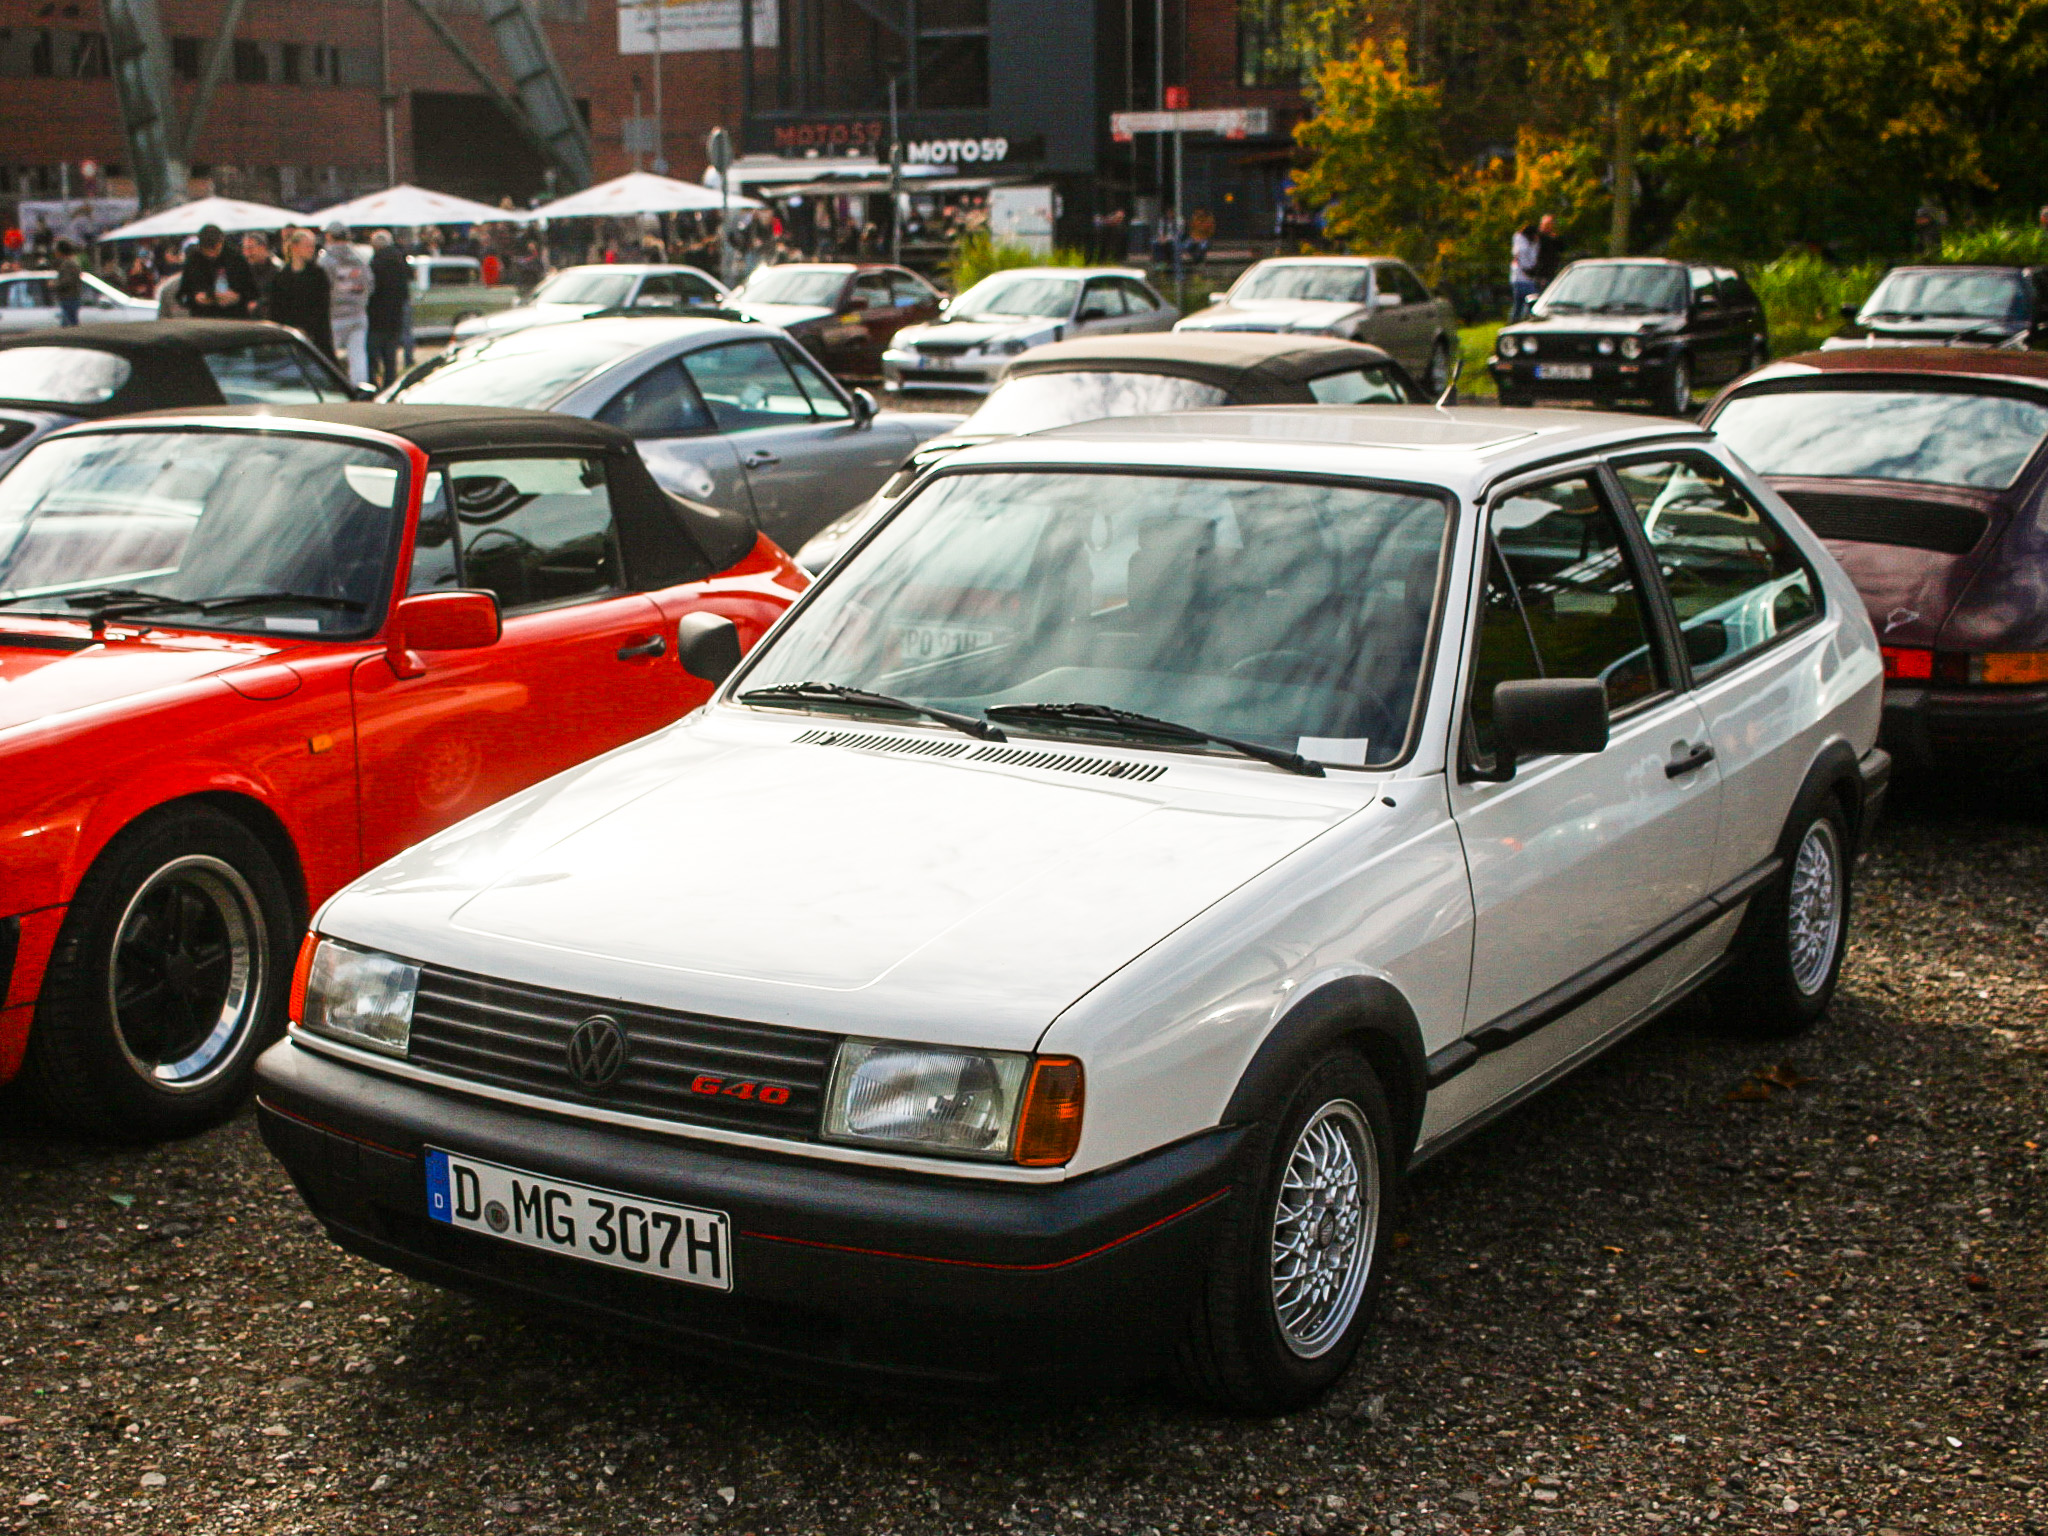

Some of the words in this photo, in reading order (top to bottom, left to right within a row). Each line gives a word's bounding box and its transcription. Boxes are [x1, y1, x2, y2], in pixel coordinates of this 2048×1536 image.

[691, 1075, 790, 1105] G40
[434, 1192, 444, 1209] D
[452, 1163, 482, 1221] D
[511, 1179, 577, 1248] MG
[588, 1197, 721, 1279] 307H
